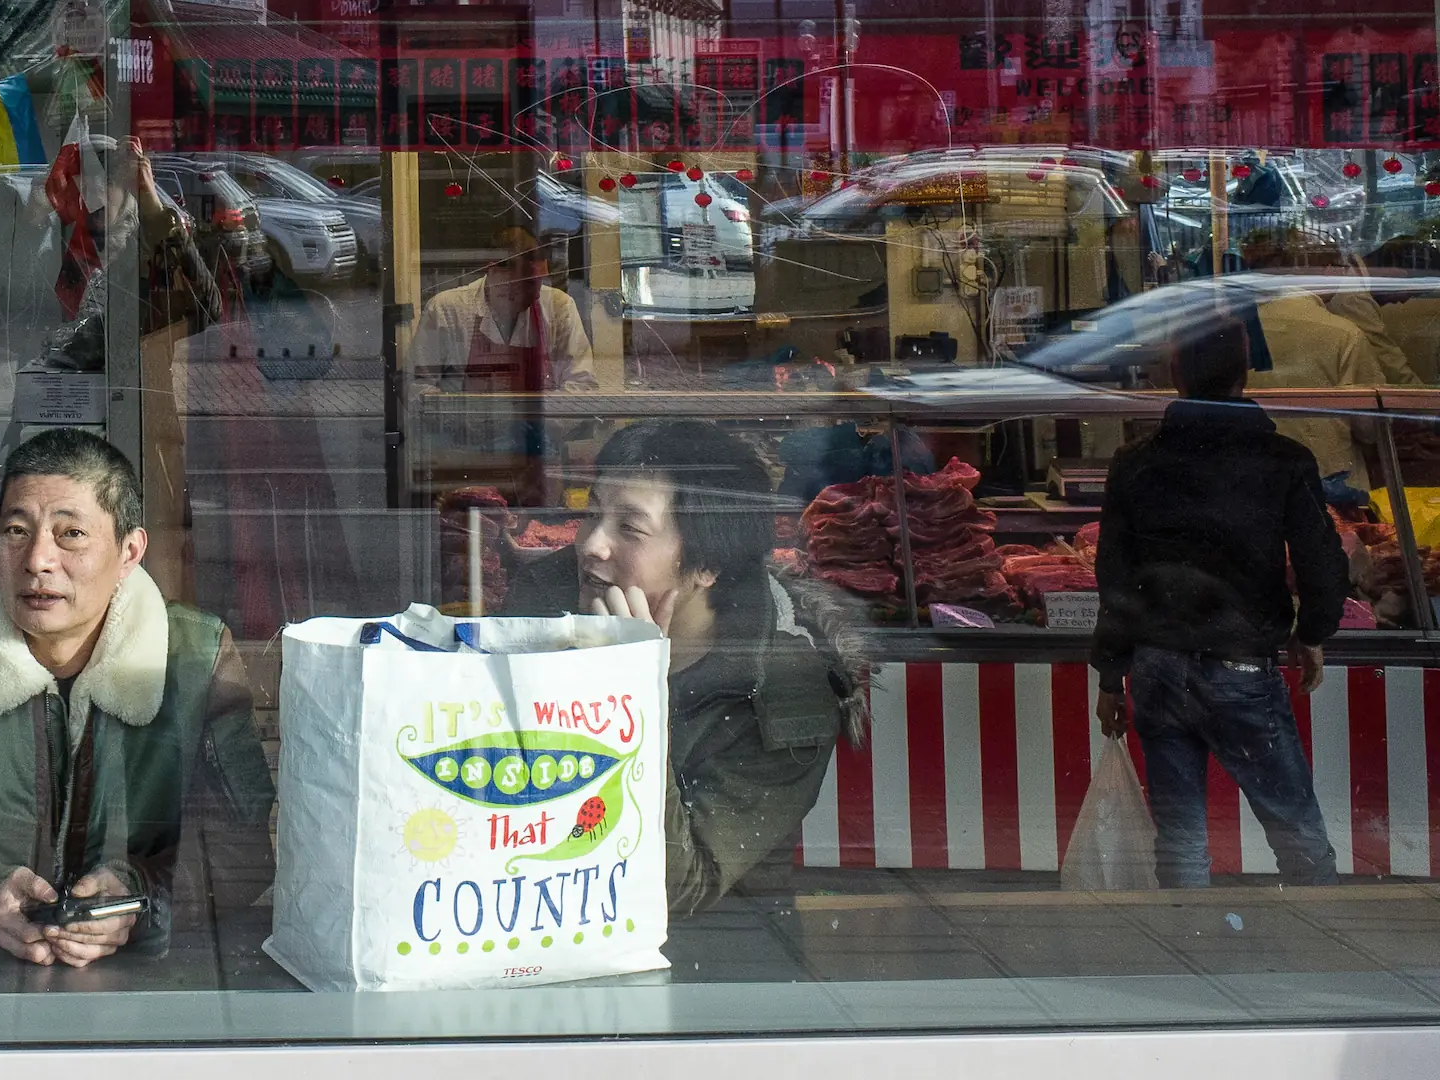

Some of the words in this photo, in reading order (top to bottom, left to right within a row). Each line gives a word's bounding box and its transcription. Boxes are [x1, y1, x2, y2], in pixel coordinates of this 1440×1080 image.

[1016, 77, 1155, 97] WELCOME
[423, 701, 506, 743] IT'S
[438, 754, 596, 785] INSIDE
[413, 859, 627, 942] COUNTS
[503, 966, 543, 976] TESCO
